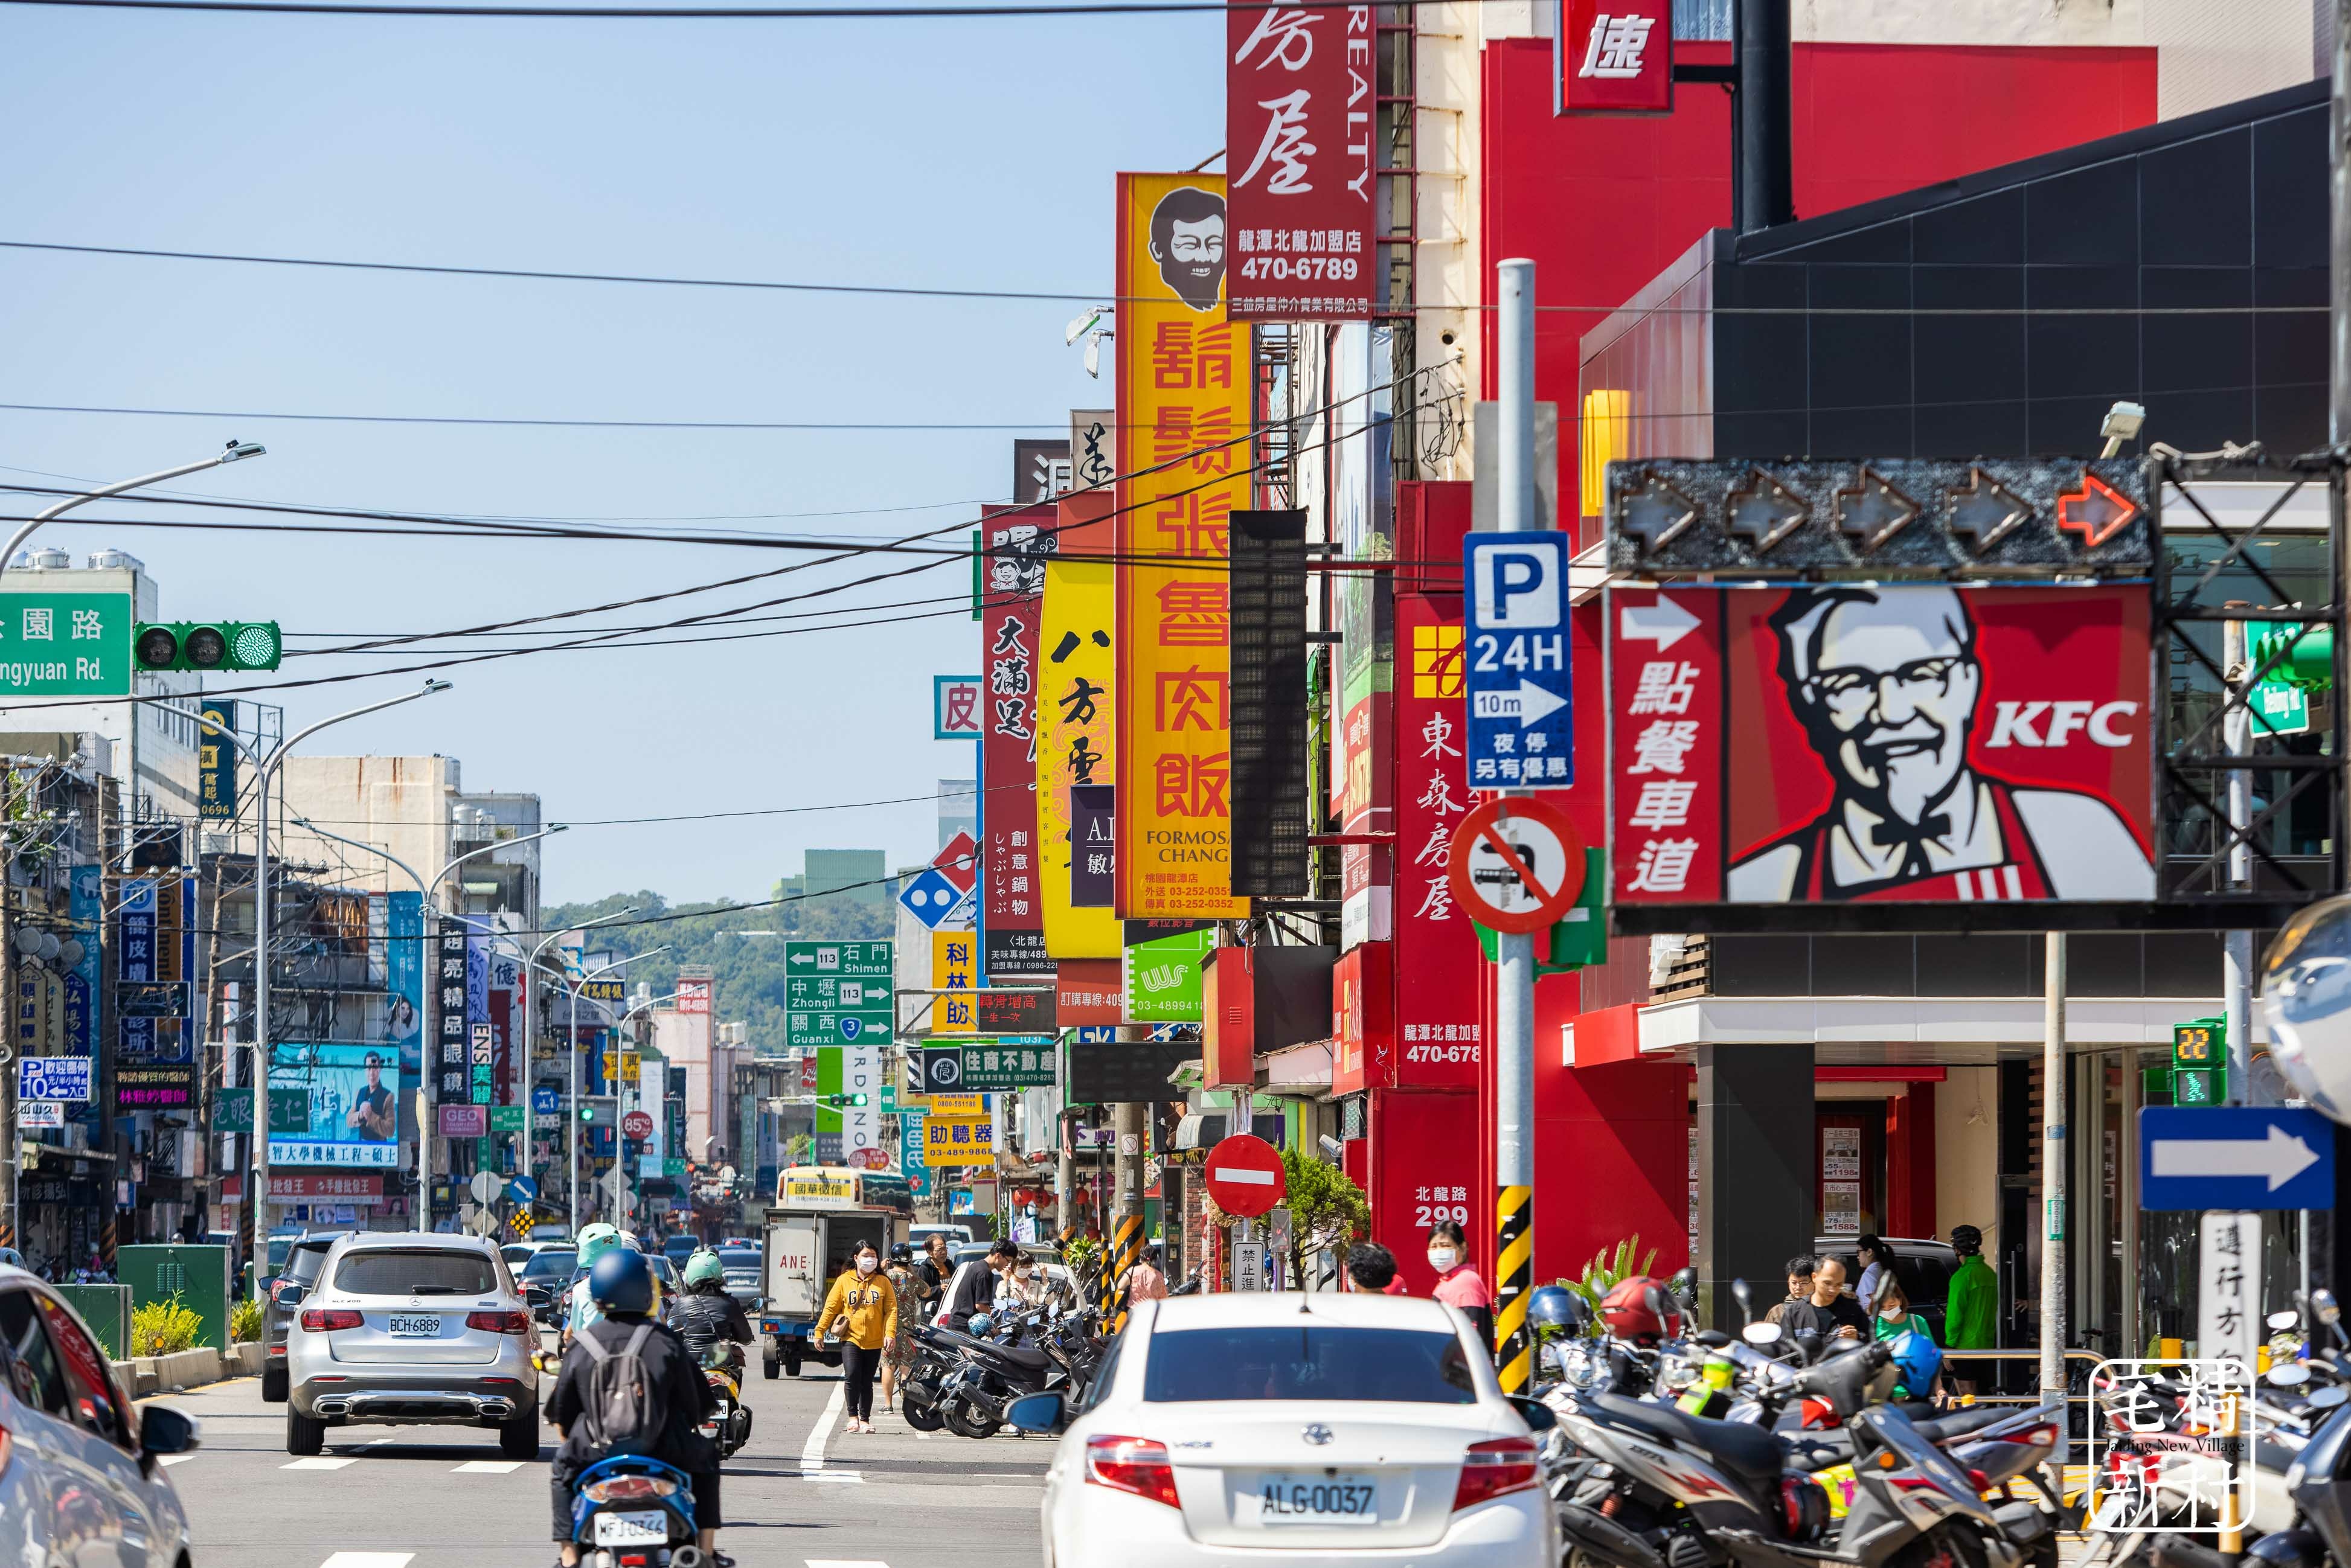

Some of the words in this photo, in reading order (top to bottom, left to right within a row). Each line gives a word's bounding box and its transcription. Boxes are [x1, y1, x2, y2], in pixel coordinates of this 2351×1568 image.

[1578, 14, 1656, 78] 速
[1347, 4, 1368, 203] REALTY
[1238, 229, 1361, 254] 龍潭北龍加盟店
[1241, 257, 1358, 280] 470-6789
[1232, 296, 1368, 314] 三益房屋仲介實業有限公司
[1493, 554, 1543, 620] P
[0, 608, 104, 641] 園路
[1474, 635, 1562, 672] 24H
[0, 662, 66, 686] ngyuan
[76, 657, 104, 680] Rd.
[992, 616, 1030, 739] 大滿足
[1986, 700, 2137, 748] KFC
[1050, 629, 1111, 868] 八方雲
[1493, 732, 1548, 754] 夜停
[1475, 757, 1567, 779] 另有優惠
[1627, 662, 1699, 892] 點餐車道
[201, 805, 229, 815] 0696
[1414, 712, 1464, 921] 東森房屋
[1147, 831, 1230, 845] FORMOS
[1159, 848, 1228, 863] CHANG
[993, 833, 1007, 914] しゃぶしゃぶ
[1012, 831, 1028, 916] 創意鍋物
[1145, 873, 1199, 883] 桃園龍潭店
[1145, 886, 1166, 897] 外送
[1145, 898, 1166, 909] 傳真
[1170, 900, 1233, 908] 03-252-0352
[819, 954, 836, 963] 113
[844, 944, 887, 961] 石門
[844, 964, 887, 973] Shimen
[792, 979, 835, 996] 中壢
[843, 989, 859, 998] 113
[792, 999, 835, 1010] Zhongli
[979, 995, 1036, 1009] 轉骨增高
[792, 1014, 835, 1032] 關西
[847, 1021, 855, 1031] 3
[793, 1034, 834, 1044] Guanxi
[2178, 1029, 2208, 1060] 22
[45, 1061, 88, 1074] 歡迎臨停
[966, 1051, 1056, 1072] 住商不動產
[22, 1078, 48, 1098] 10
[69, 1087, 87, 1098] 入口
[446, 1110, 478, 1121] GEO
[930, 1124, 992, 1144] 助聽器
[268, 1145, 396, 1162] 智大學機械工程-碩士
[930, 1148, 993, 1157] 03-489-9868
[1415, 1186, 1467, 1202] 北龍路
[1415, 1206, 1468, 1227] 299
[1242, 1249, 1256, 1290] 禁止進
[848, 1290, 880, 1305] GAP
[390, 1319, 440, 1332] BCH-6889
[1263, 1485, 1374, 1515] ALG-0037
